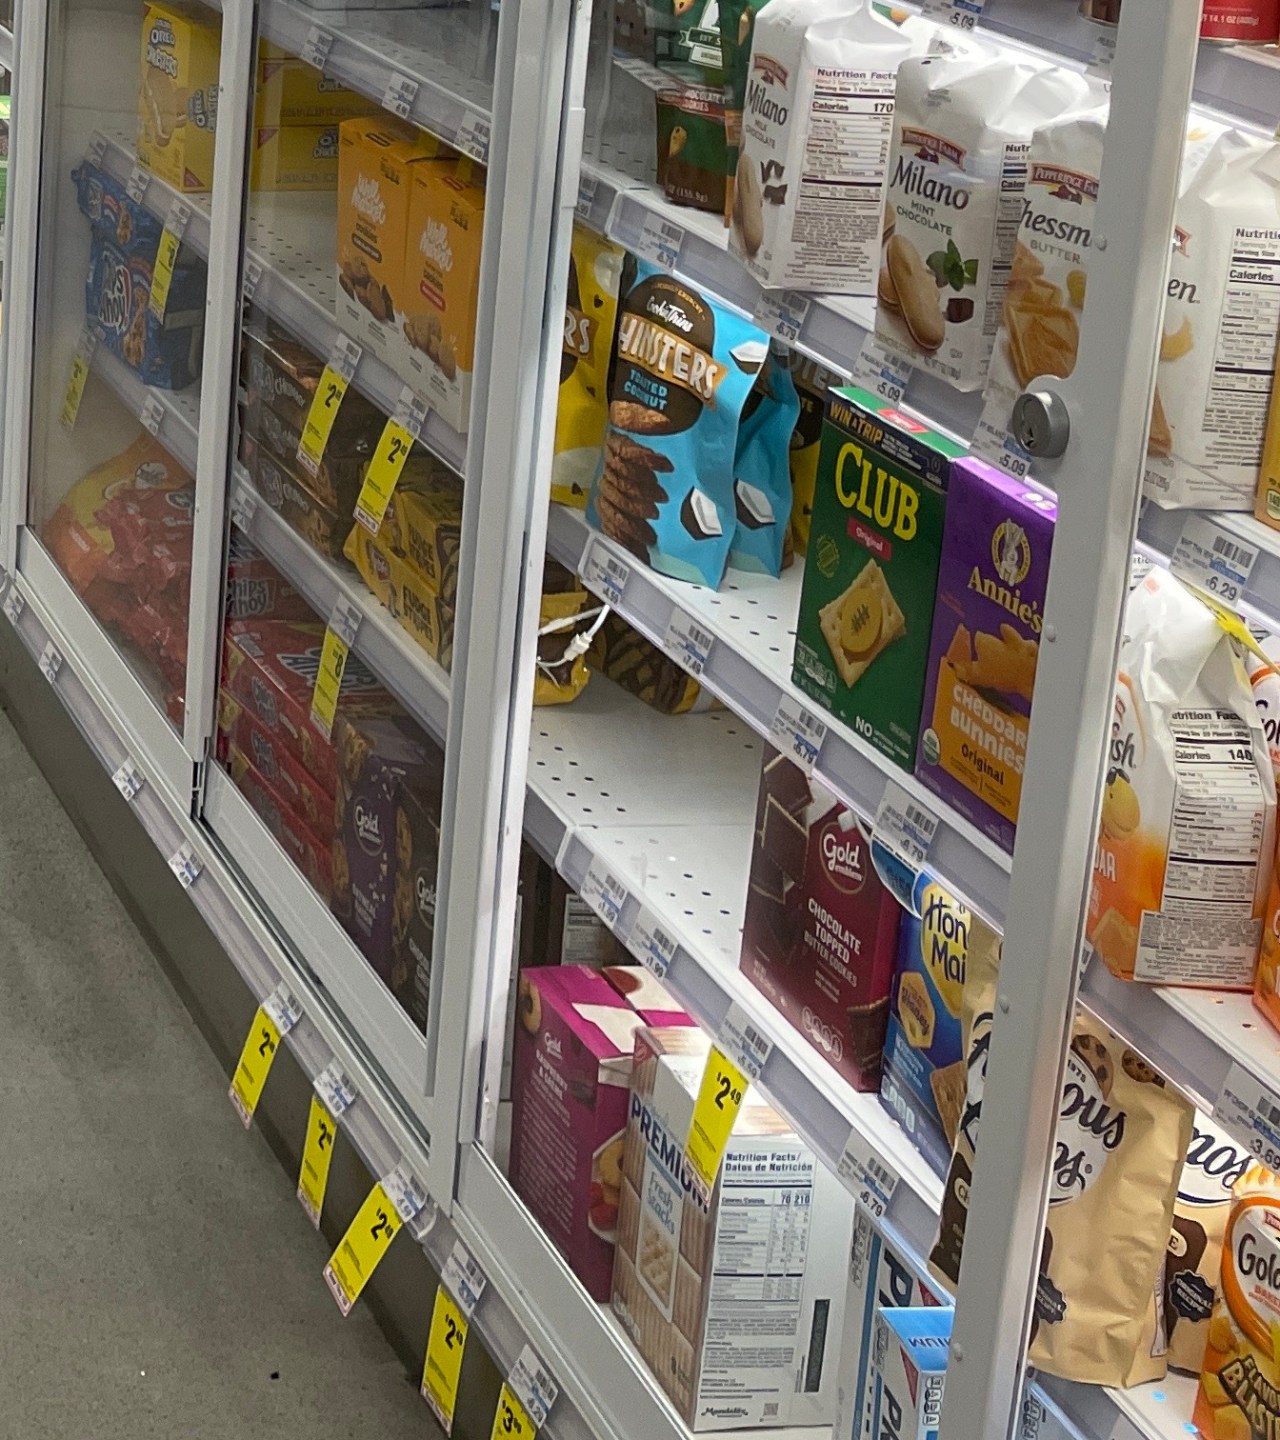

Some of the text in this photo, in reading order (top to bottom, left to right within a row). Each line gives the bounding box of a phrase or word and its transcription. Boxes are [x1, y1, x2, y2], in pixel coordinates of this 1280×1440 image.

[949, 12, 976, 31] $5.09
[151, 27, 176, 47] OREO
[817, 68, 868, 80] Nutrition
[746, 79, 789, 128] Milano
[812, 101, 895, 114] Calories 170
[745, 124, 777, 151] CHOCOLATE
[890, 155, 971, 212] Milano
[895, 204, 954, 237] CHOCOLATE
[910, 199, 936, 218] MINT
[1030, 239, 1082, 265] BUTTER
[1229, 268, 1275, 282] Calories
[875, 381, 902, 405] $5.09
[827, 398, 885, 446] WIN TRIP
[997, 454, 1028, 479] $5.09
[834, 442, 921, 543] CLUB
[855, 526, 884, 554] Original
[967, 566, 1044, 635] Annie's
[1204, 575, 1238, 600] $6.29
[854, 714, 875, 741] NO
[960, 742, 1006, 786] Original
[1175, 748, 1254, 763] Calories 140
[354, 804, 380, 836] Gold
[821, 831, 861, 870] Gold
[807, 896, 862, 956] CHOCOLATE
[813, 920, 851, 966] TOPPED
[803, 930, 858, 990] BUTTER COOKIES
[724, 1161, 814, 1173] Datos de Nutrición
[725, 1151, 802, 1164] Nutrition Facts/
[648, 1170, 674, 1214] Fresh
[794, 1194, 811, 1206] 210
[859, 1189, 884, 1217] $6.79
